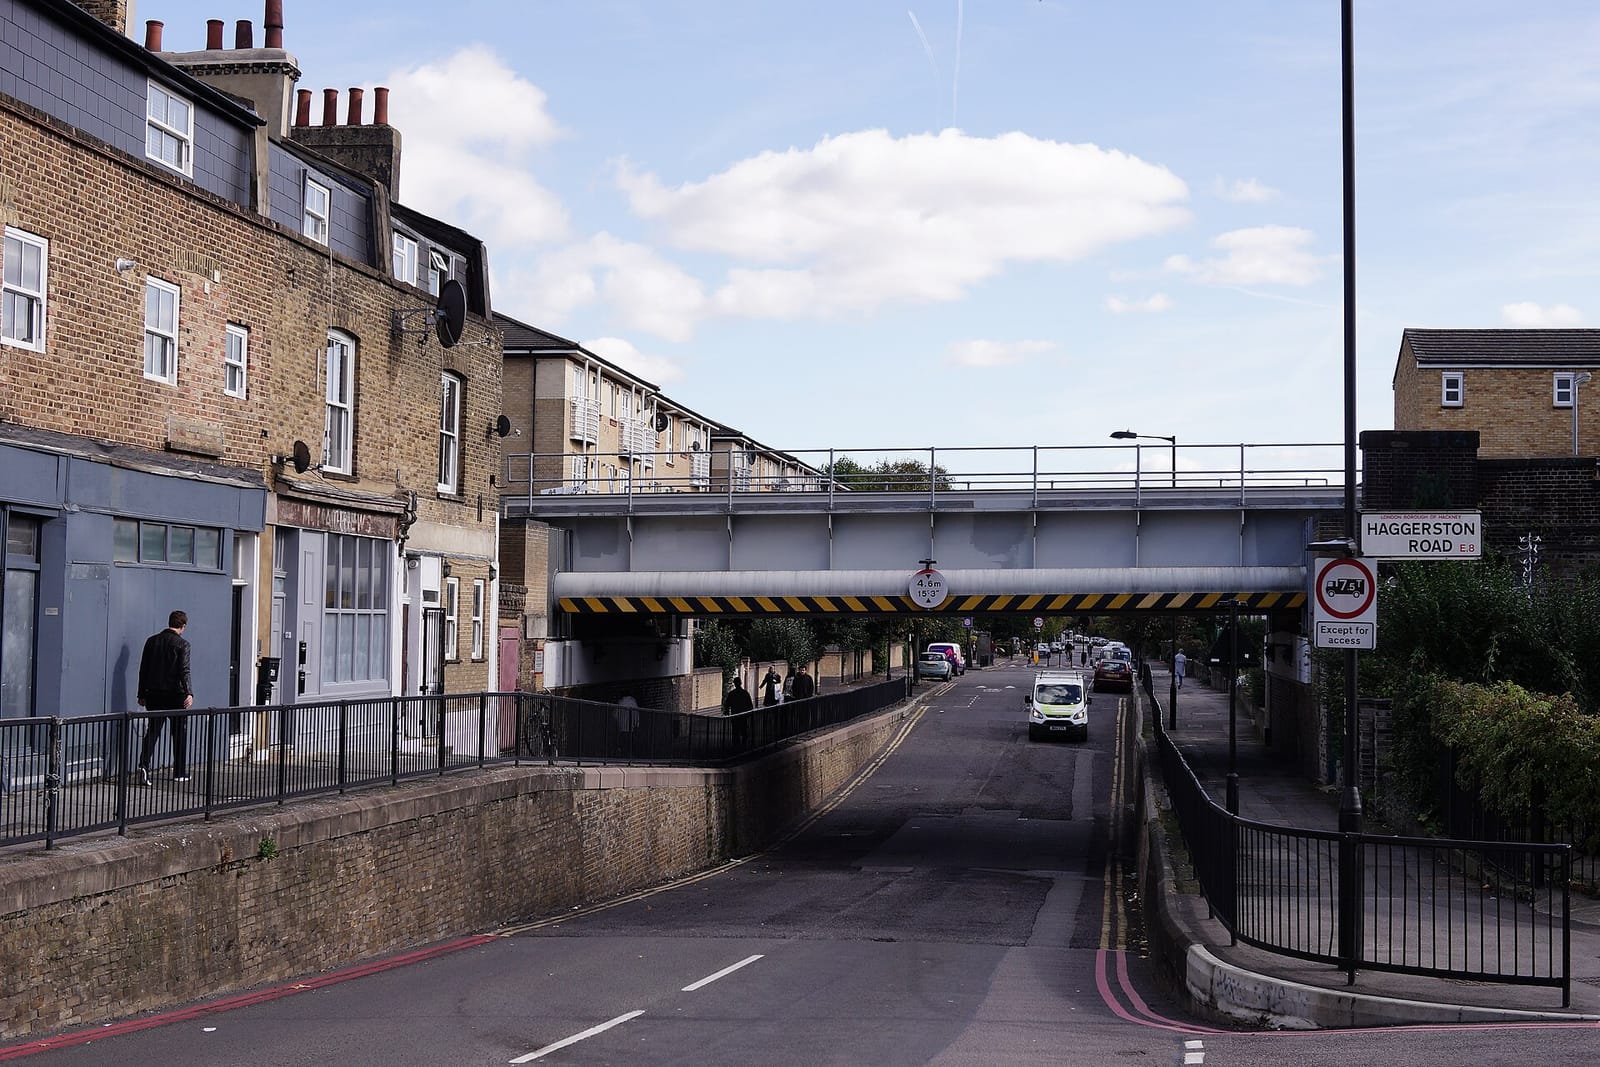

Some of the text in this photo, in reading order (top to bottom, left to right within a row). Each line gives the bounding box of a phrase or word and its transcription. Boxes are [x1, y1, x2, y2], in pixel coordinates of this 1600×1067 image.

[1367, 522, 1475, 536] HAGGERSTON
[1409, 539, 1453, 553] ROAD
[916, 579, 942, 588] 4.6m
[1320, 625, 1369, 636] Except for
[1328, 637, 1361, 645] access
